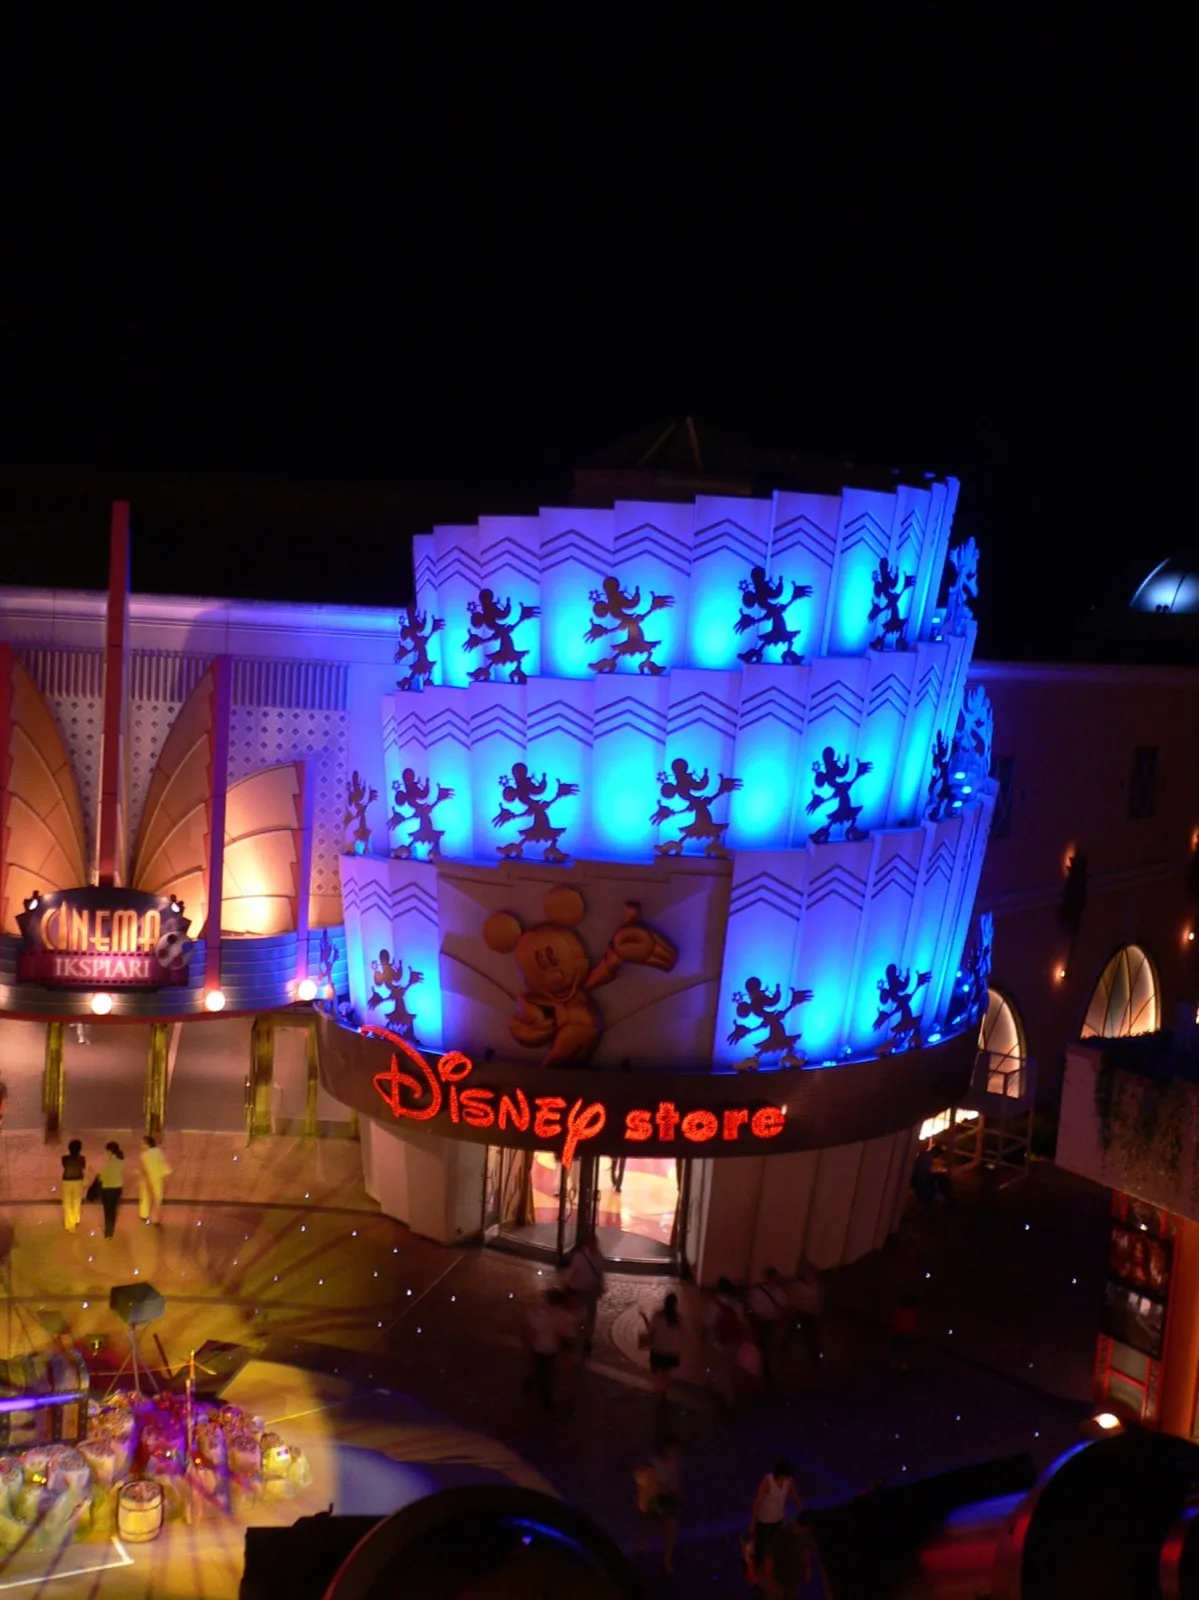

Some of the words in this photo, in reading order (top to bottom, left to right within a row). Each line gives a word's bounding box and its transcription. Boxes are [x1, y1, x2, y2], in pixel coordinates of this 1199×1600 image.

[40, 901, 162, 953] CINEMA
[55, 957, 152, 979] IKSPIARI
[624, 1101, 788, 1142] store
